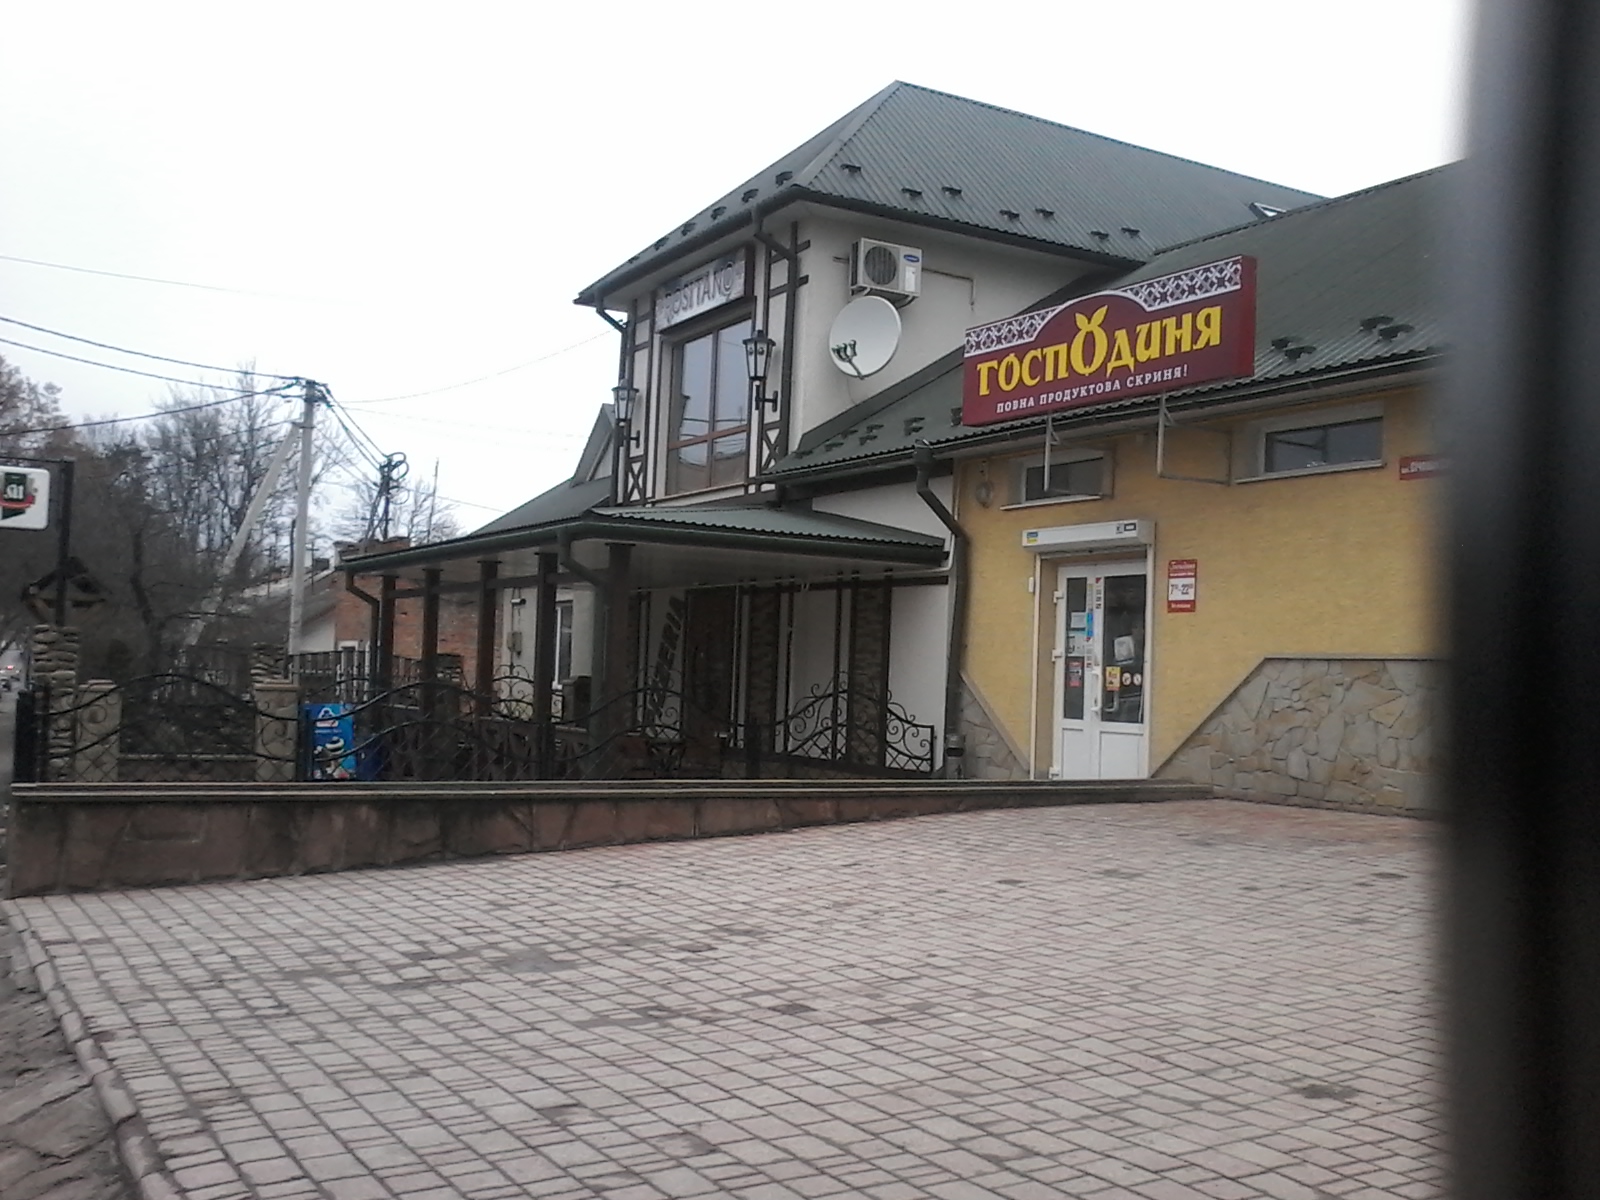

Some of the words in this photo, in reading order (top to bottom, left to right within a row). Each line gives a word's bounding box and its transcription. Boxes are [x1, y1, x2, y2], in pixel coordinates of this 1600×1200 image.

[977, 304, 1222, 396] ГОСПОДИНЯ
[996, 397, 1035, 414] ПОВНА
[1039, 382, 1121, 405] ПРОДУКТОВА
[1126, 363, 1189, 388] СКРИНЯ!
